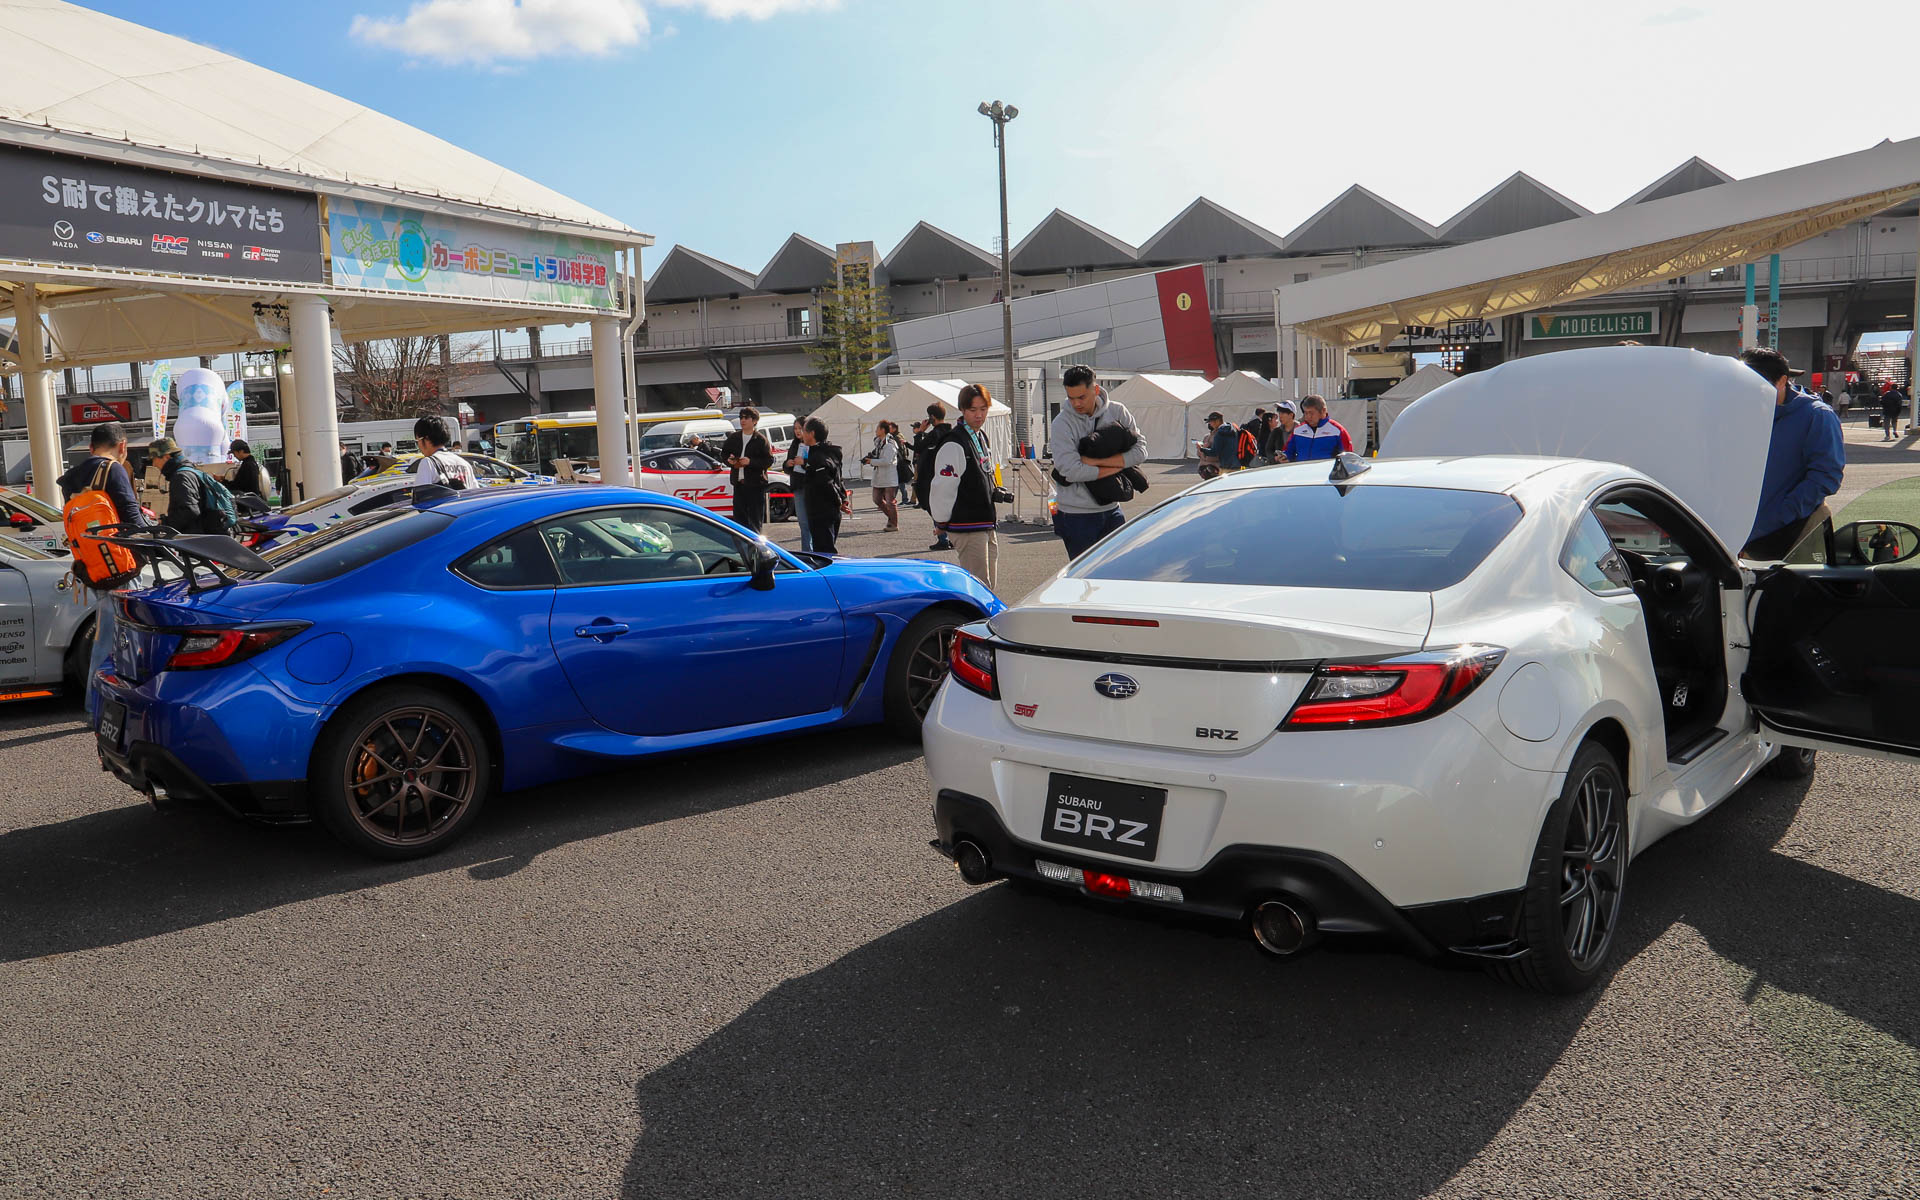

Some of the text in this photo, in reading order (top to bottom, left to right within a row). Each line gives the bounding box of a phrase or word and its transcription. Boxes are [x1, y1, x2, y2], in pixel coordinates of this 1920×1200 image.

[42, 175, 285, 233] S耐で鍛えたクルマたち
[52, 241, 79, 249] MAZDA
[106, 235, 142, 246] SUBARU
[152, 234, 189, 251] HRC
[197, 240, 233, 250] NISSAN
[432, 242, 608, 287] カーボンニュートラル科学館
[1560, 315, 1644, 334] MODELLISTA
[1832, 360, 1841, 371] J
[673, 485, 729, 500] GT4
[0, 618, 24, 626] arrett
[100, 720, 119, 743] BRZ
[1195, 727, 1239, 741] BRZ
[1058, 794, 1102, 811] SUBARU
[1053, 807, 1149, 847] BRZ
